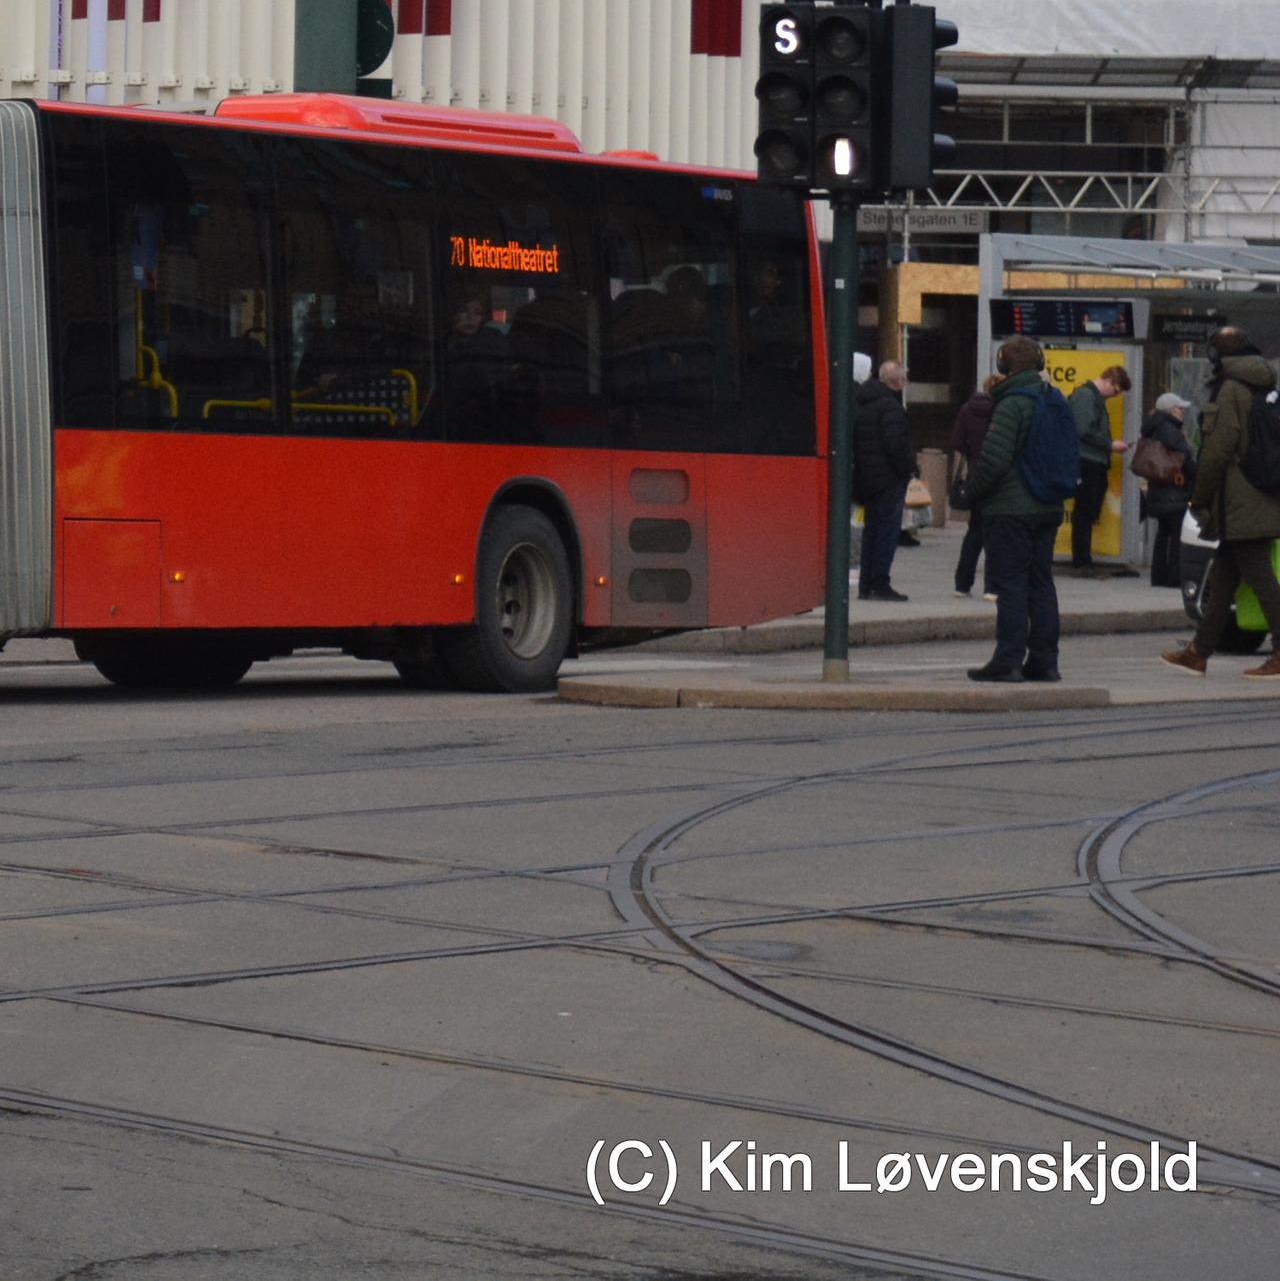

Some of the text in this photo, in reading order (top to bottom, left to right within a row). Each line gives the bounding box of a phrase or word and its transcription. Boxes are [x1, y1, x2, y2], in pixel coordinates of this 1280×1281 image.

[863, 210, 957, 228] Steesgaten
[450, 237, 559, 273] 70 Nationaltheatret
